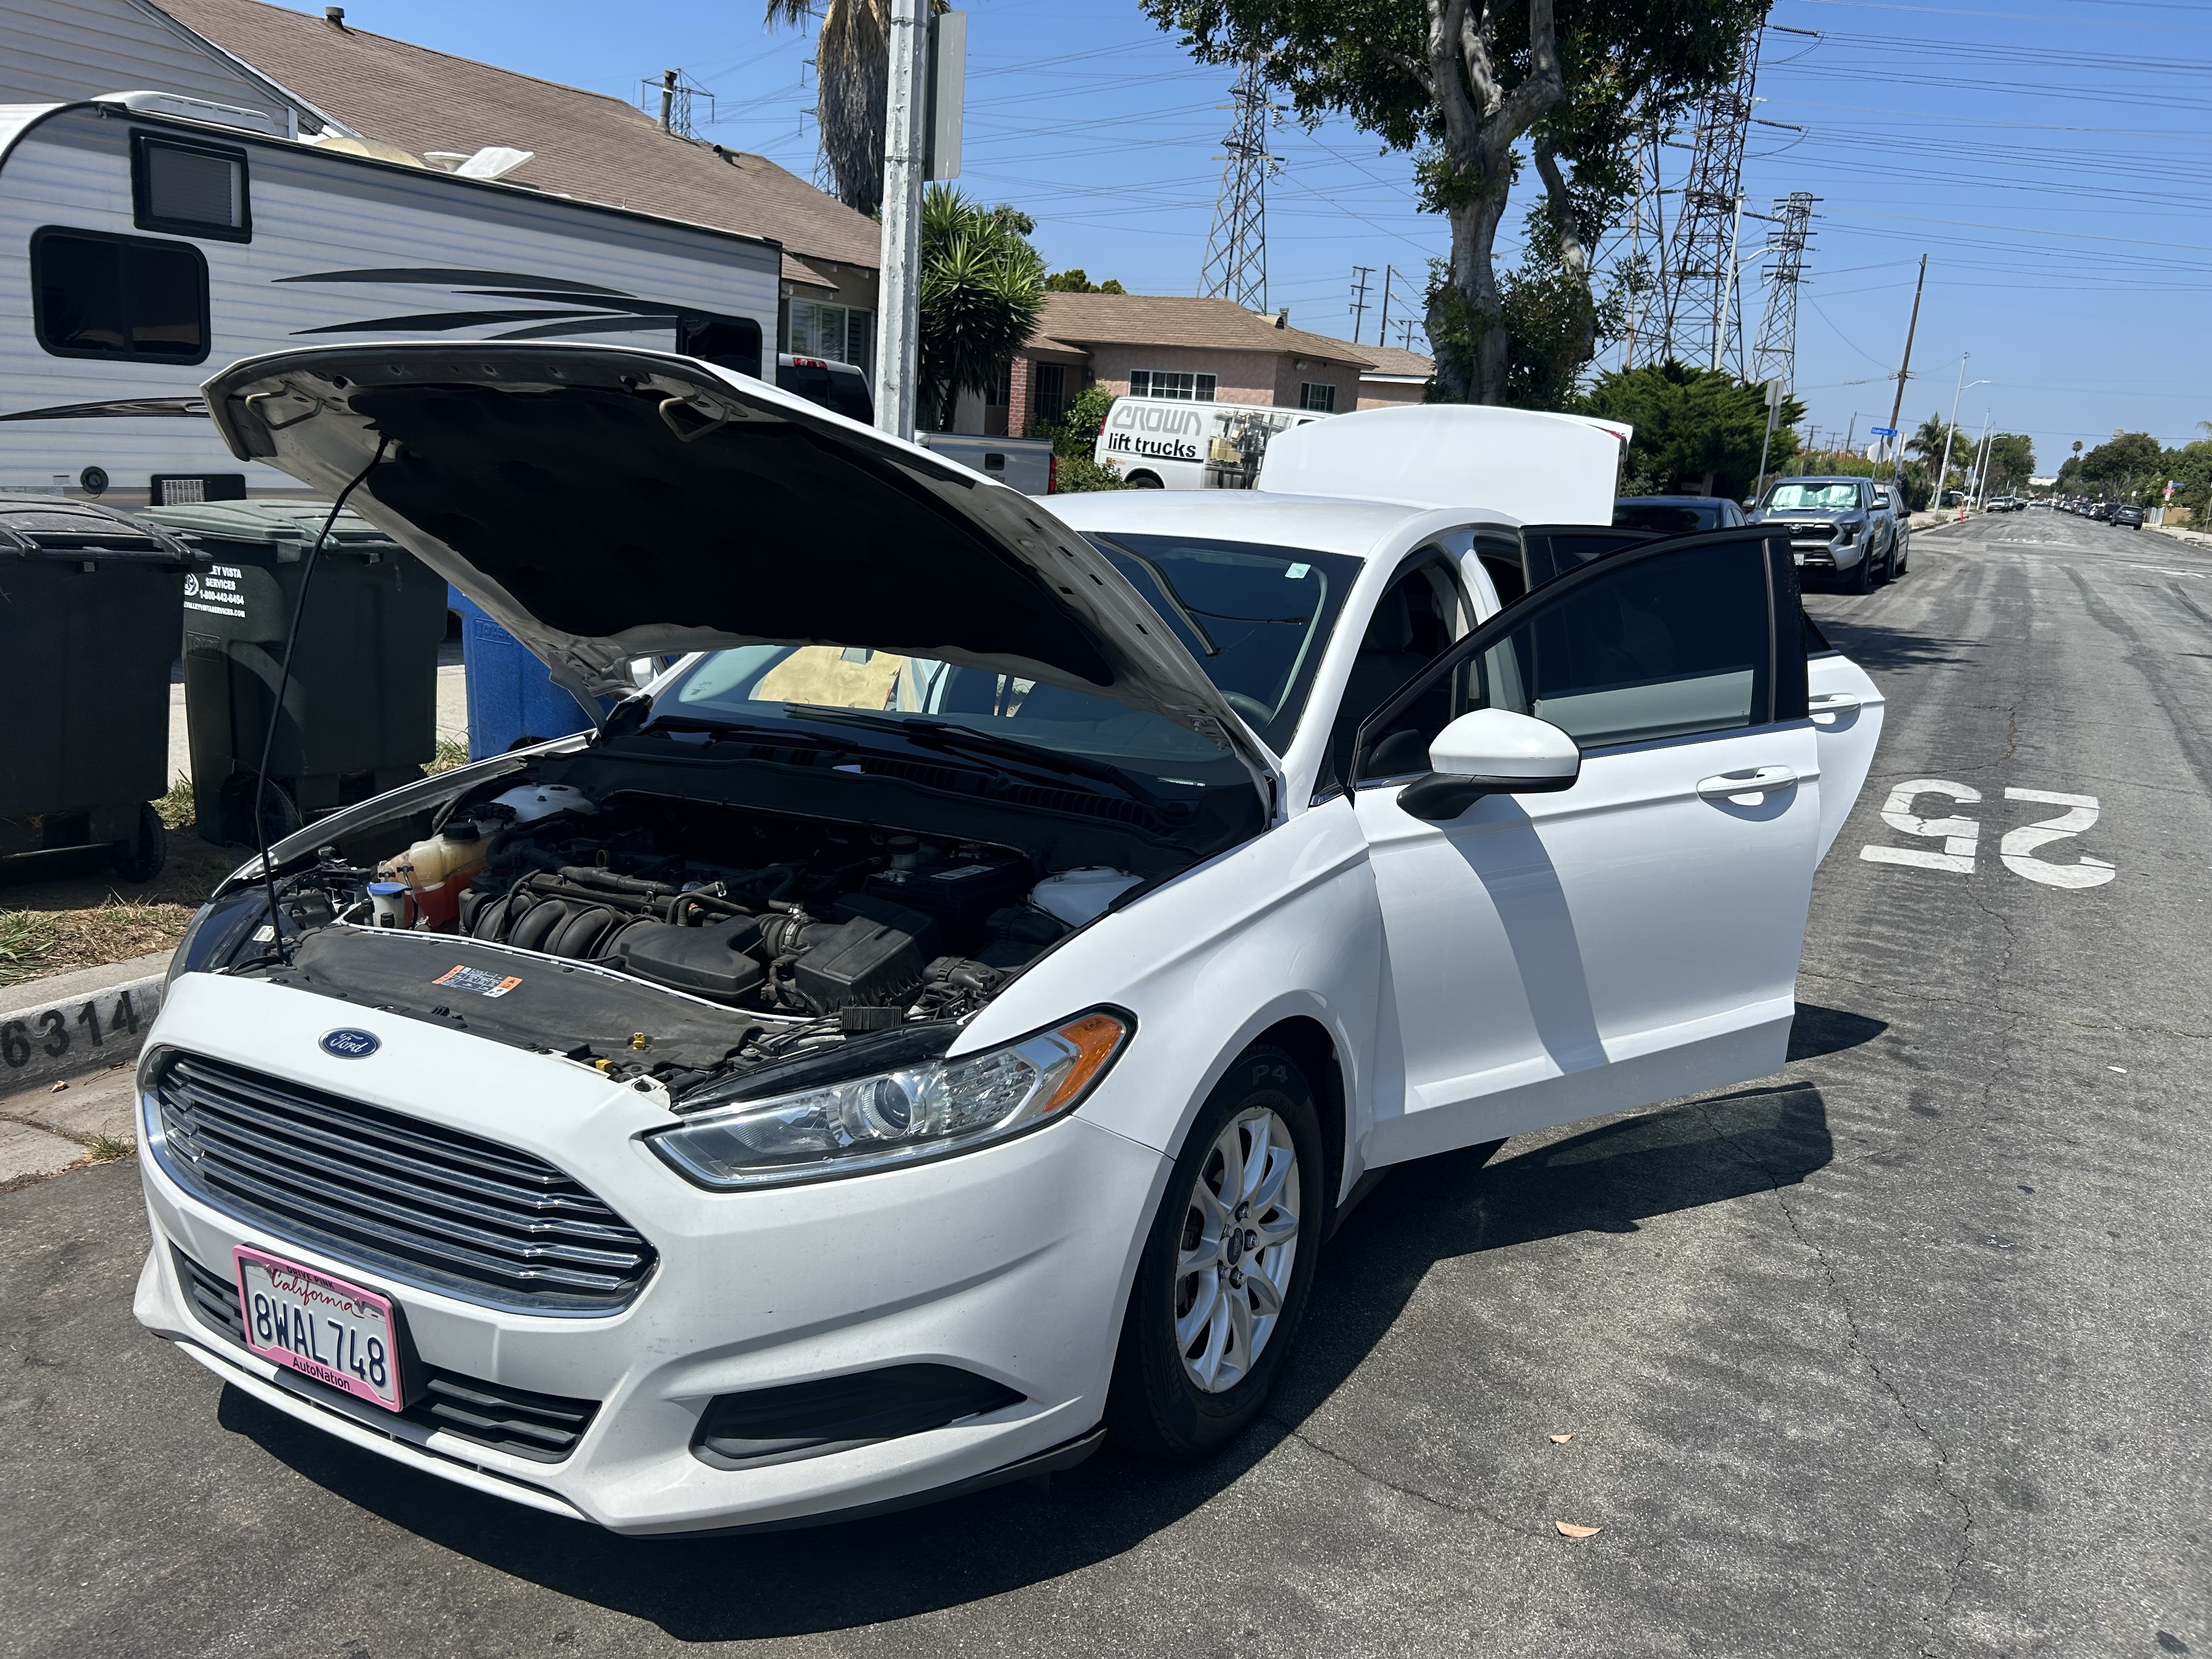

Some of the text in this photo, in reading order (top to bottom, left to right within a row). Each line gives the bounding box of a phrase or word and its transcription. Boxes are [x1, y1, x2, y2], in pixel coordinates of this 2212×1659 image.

[1112, 405, 1202, 436] CROWN
[1108, 432, 1197, 458] lift trucks
[205, 577, 236, 591] SERVICES
[222, 566, 242, 579] VISTA
[1860, 779, 2115, 889] 25
[1, 991, 139, 1068] 6314
[330, 1032, 369, 1053] Ford
[1252, 1064, 1288, 1086] P4
[286, 1265, 335, 1289] DRIVE PINK
[271, 1268, 365, 1319] California
[255, 1293, 386, 1387] 8WAL748
[292, 1357, 351, 1392] AutoNation
